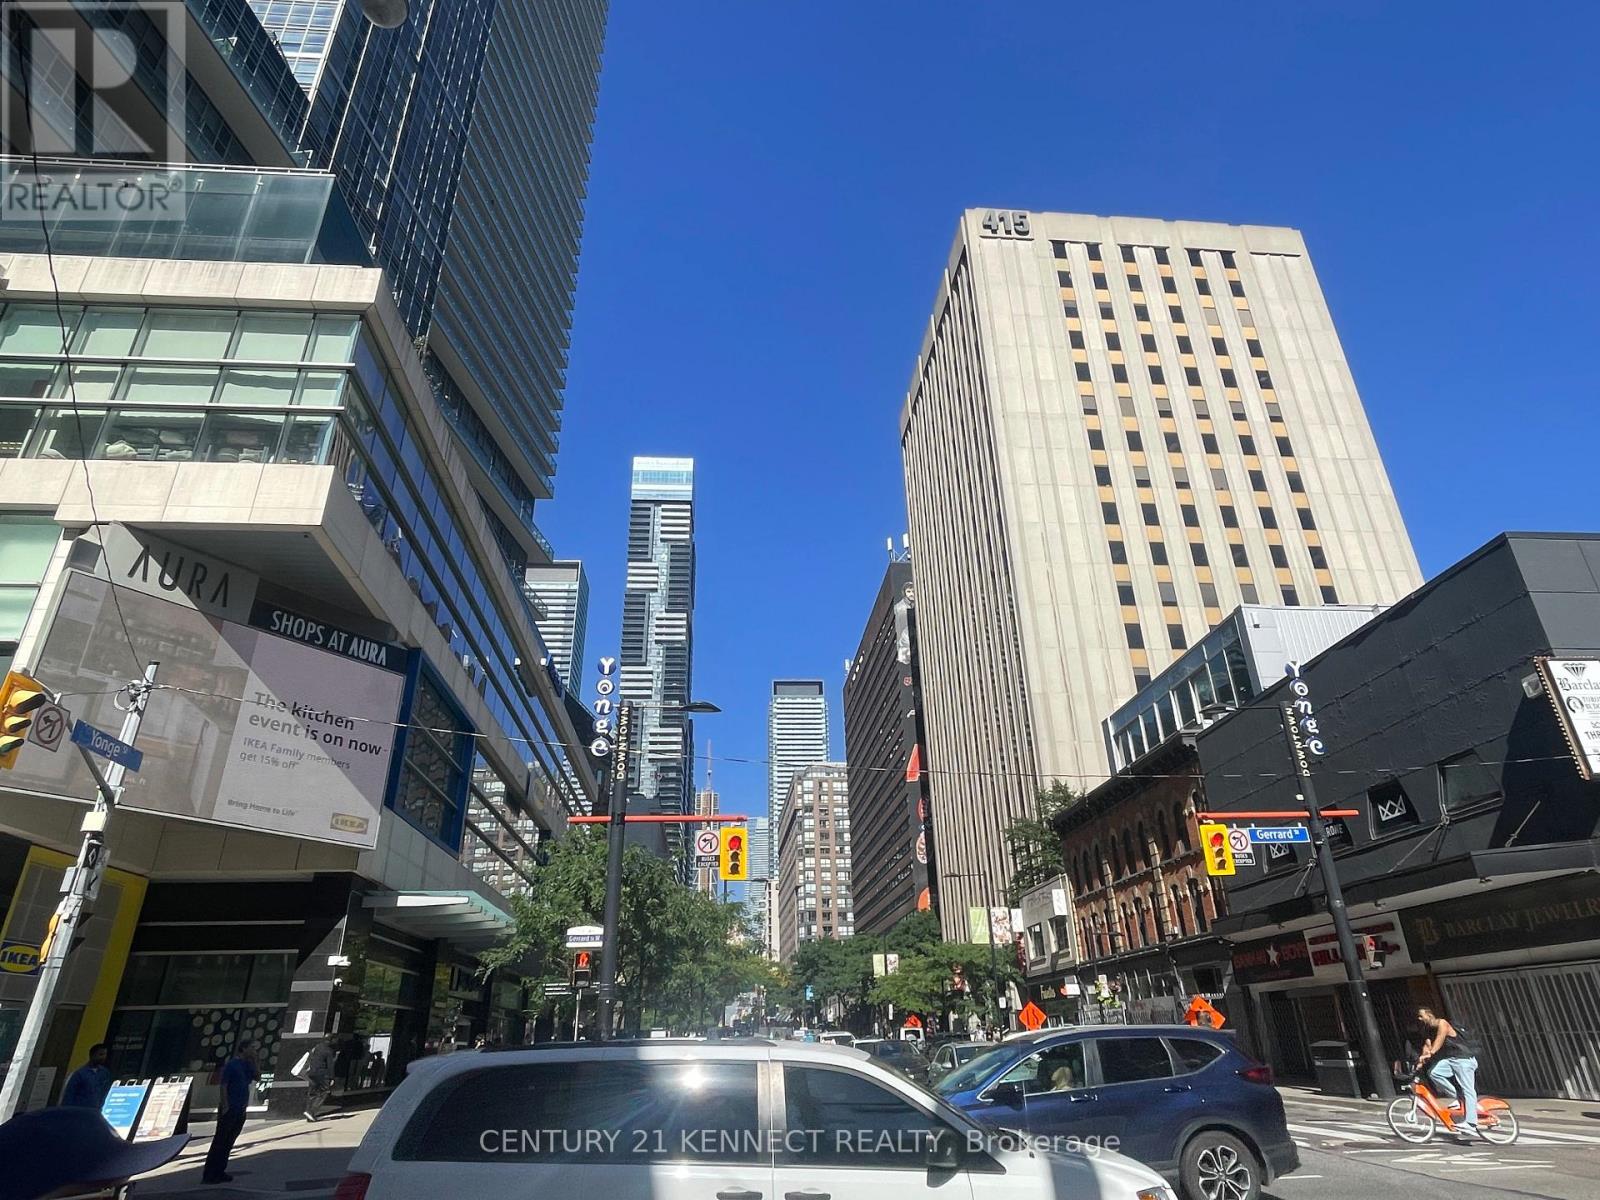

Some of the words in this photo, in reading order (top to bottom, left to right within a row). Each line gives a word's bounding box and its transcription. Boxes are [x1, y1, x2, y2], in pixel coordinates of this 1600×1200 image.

[982, 209, 1031, 236] 415
[127, 545, 229, 608] AURA
[270, 610, 325, 645] SHOPS
[327, 630, 349, 653] AT
[350, 638, 387, 667] AURA
[1556, 677, 1600, 692] Barcla
[254, 691, 287, 713] The
[291, 701, 354, 731] kitchen
[590, 656, 615, 757] Yonge
[1286, 660, 1325, 755] Yonge
[89, 729, 121, 757] Yonge
[248, 714, 301, 737] event
[304, 725, 318, 741] is
[323, 732, 343, 747] on
[348, 739, 382, 755] now
[616, 707, 629, 780] DOWNTOWN
[1285, 707, 1311, 777] DOWNTOWN
[239, 751, 257, 762] get
[260, 754, 279, 767] 15%
[243, 737, 267, 751] IKEA
[270, 743, 305, 760] Family
[305, 753, 350, 769] members
[272, 806, 281, 814] to
[1256, 828, 1293, 840] Gerrard
[1524, 896, 1600, 932] JEWELR
[1, 951, 39, 967] IKEA
